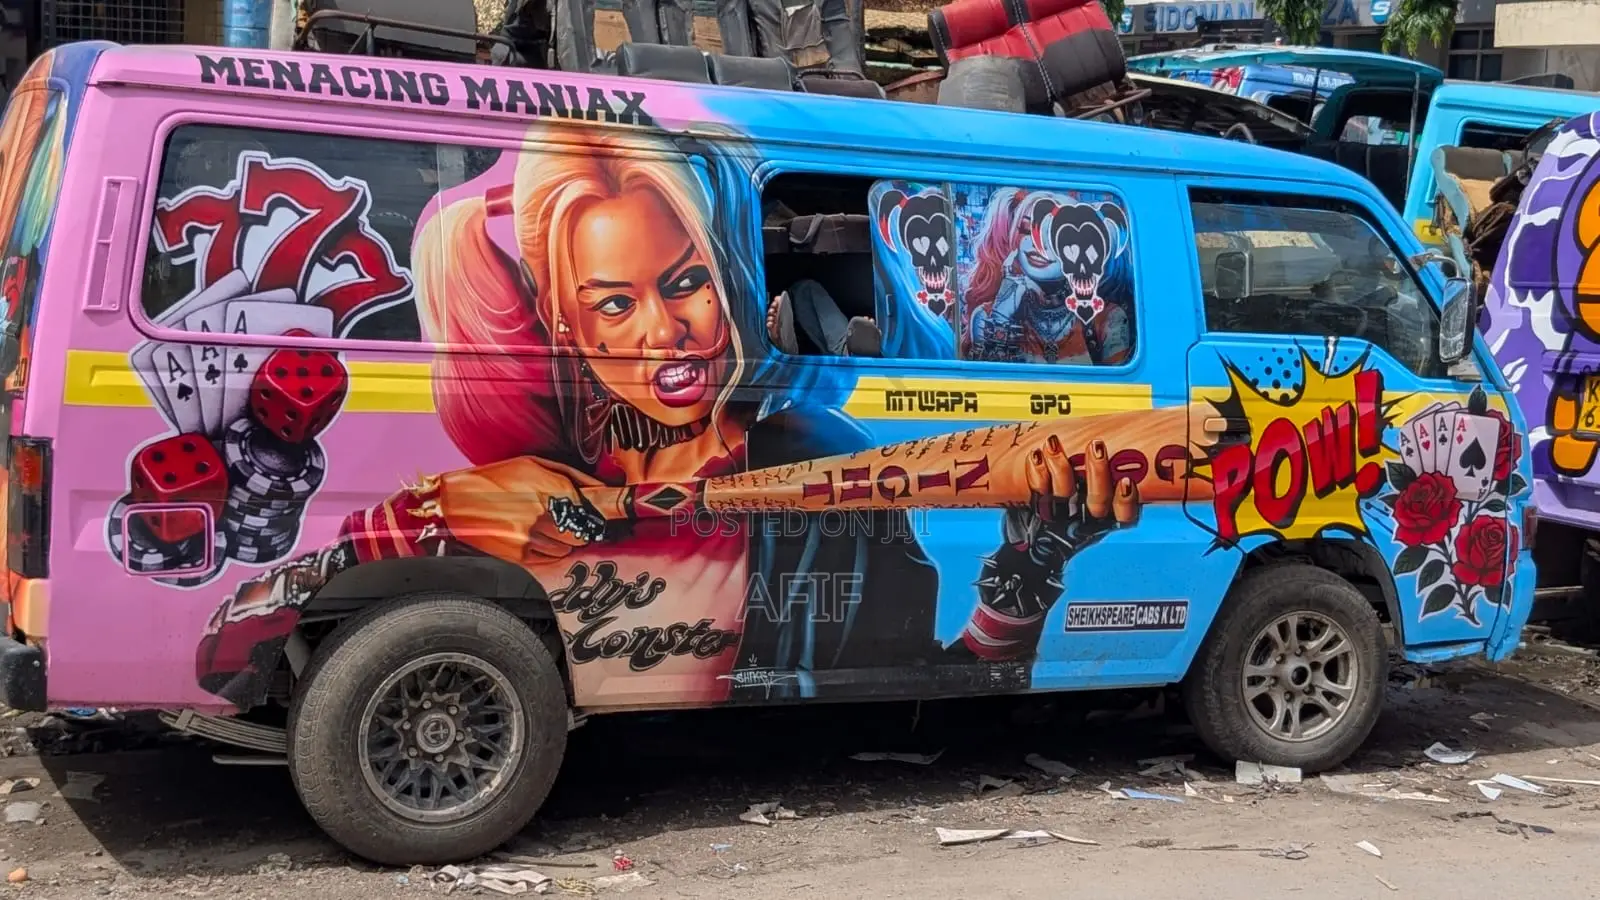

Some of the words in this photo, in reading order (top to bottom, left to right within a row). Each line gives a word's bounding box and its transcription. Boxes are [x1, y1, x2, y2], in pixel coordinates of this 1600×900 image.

[195, 54, 449, 106] MENACING
[459, 75, 653, 126] MANIAX
[166, 351, 187, 383] A
[885, 390, 978, 413] MTWAPA
[1030, 394, 1071, 415] GPO
[1419, 423, 1429, 439] A
[1438, 416, 1448, 432] A
[1456, 417, 1467, 432] A
[1210, 368, 1390, 550] POW!
[802, 454, 990, 505] NIGHT
[1067, 606, 1136, 626] SHEIKHSPEARE
[1136, 605, 1161, 625] CABS
[1160, 606, 1169, 625] K
[1169, 605, 1187, 625] LTD
